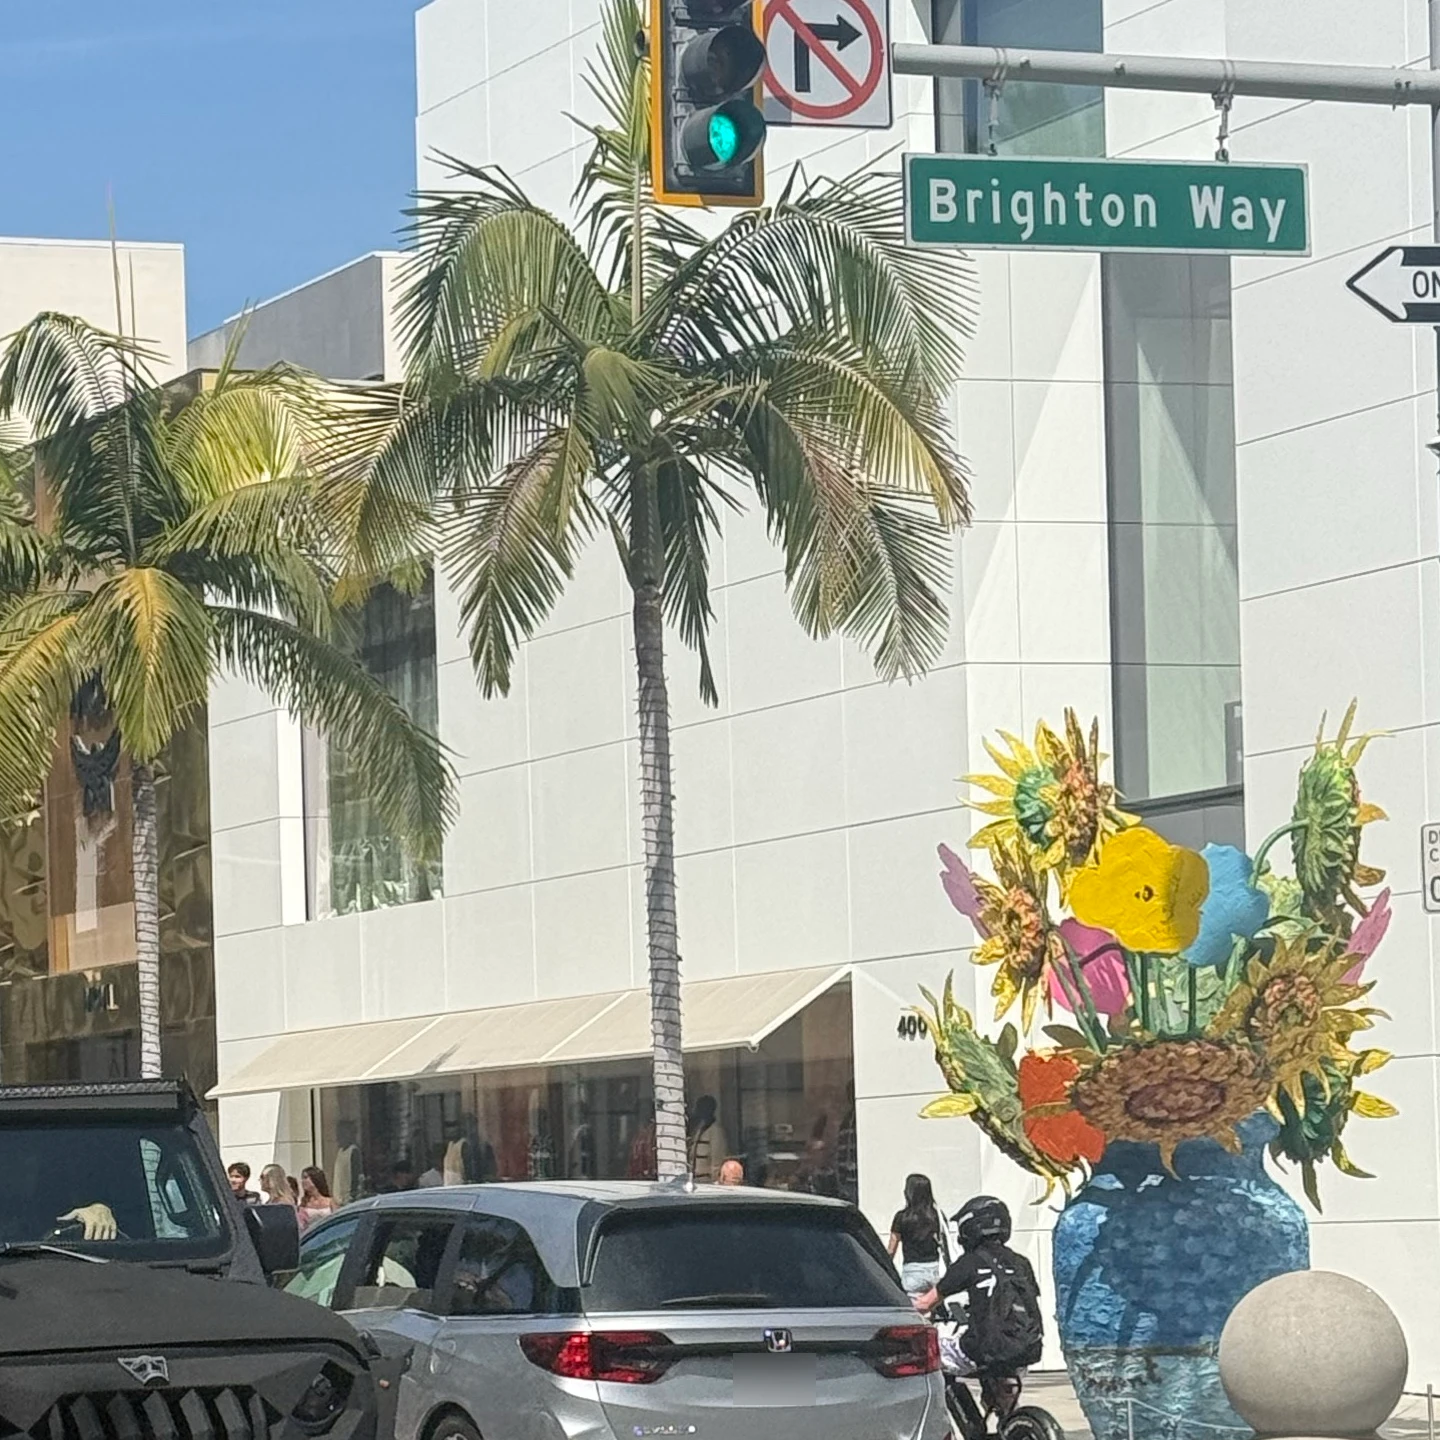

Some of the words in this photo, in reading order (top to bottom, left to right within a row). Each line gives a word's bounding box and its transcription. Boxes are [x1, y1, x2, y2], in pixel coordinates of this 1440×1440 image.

[928, 178, 1158, 241] Brighton
[1189, 184, 1287, 243] Way
[897, 1015, 928, 1038] 400
